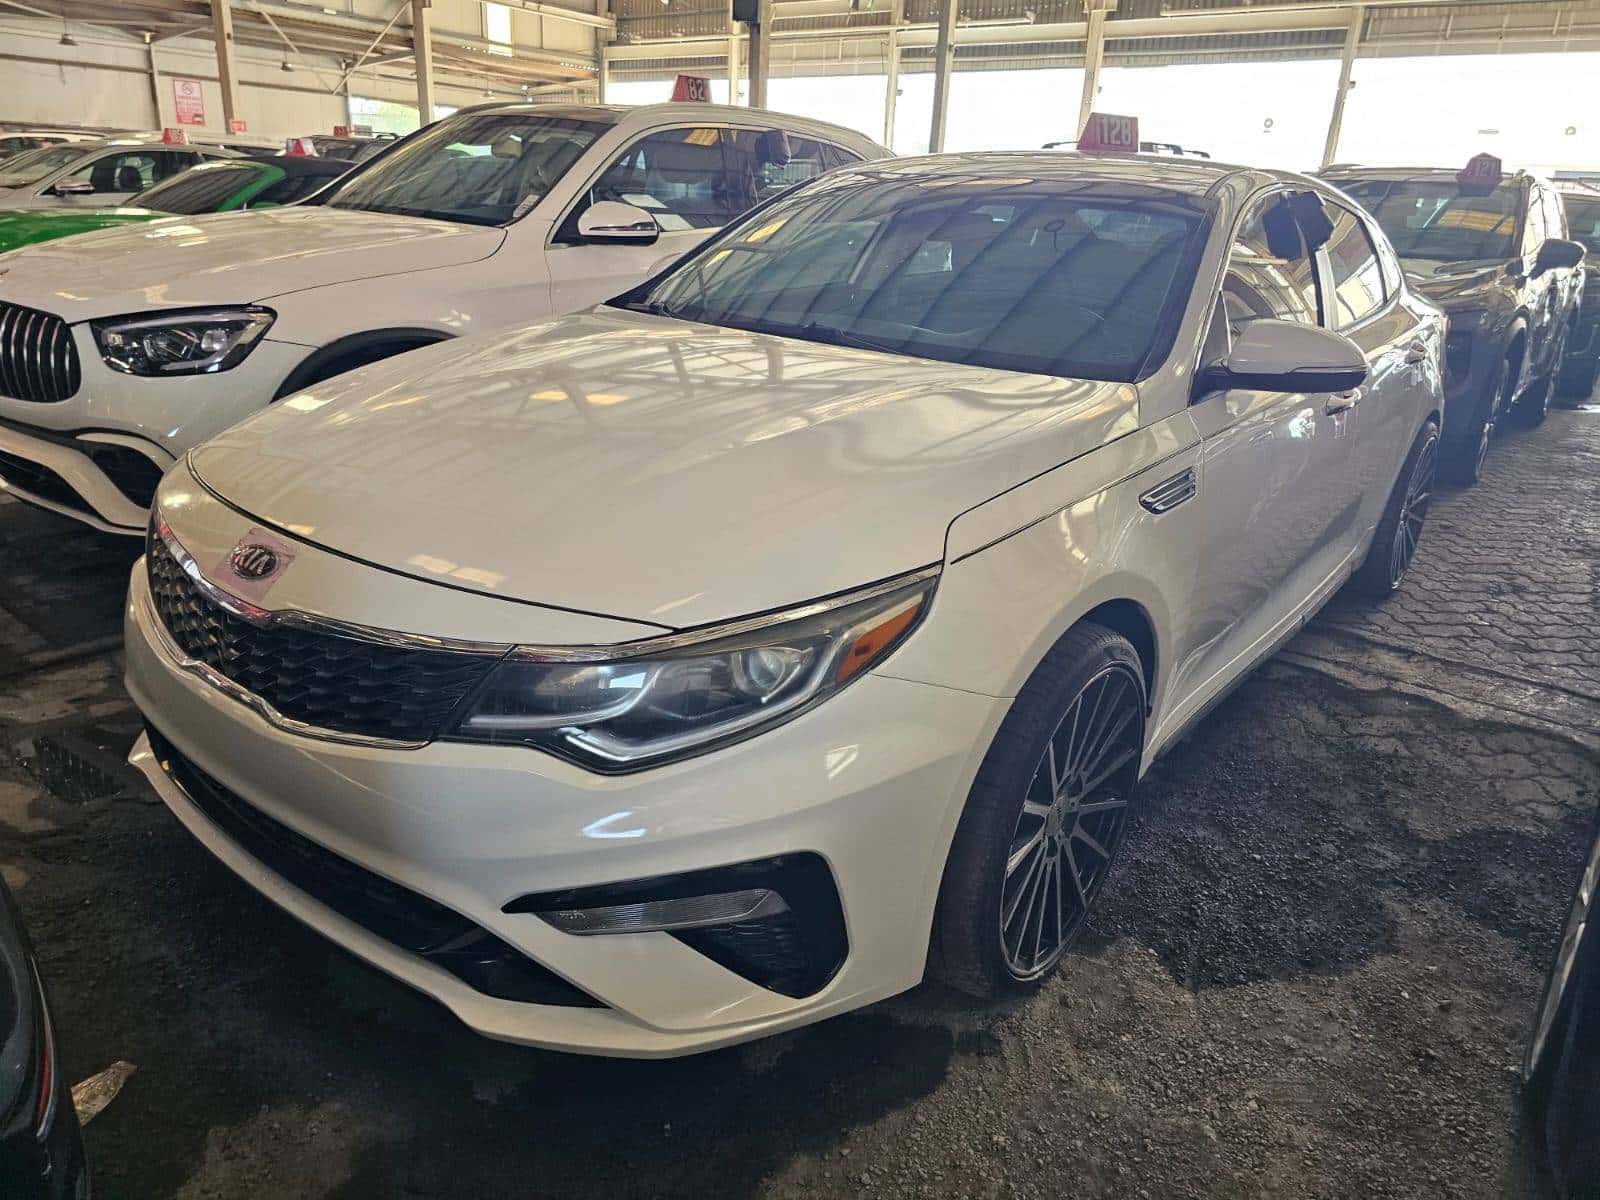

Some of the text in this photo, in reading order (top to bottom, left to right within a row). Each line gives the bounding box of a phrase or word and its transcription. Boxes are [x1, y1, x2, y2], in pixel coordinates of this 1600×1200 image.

[688, 78, 705, 101] 82
[1101, 116, 1132, 145] 128
[233, 547, 272, 576] KIA
